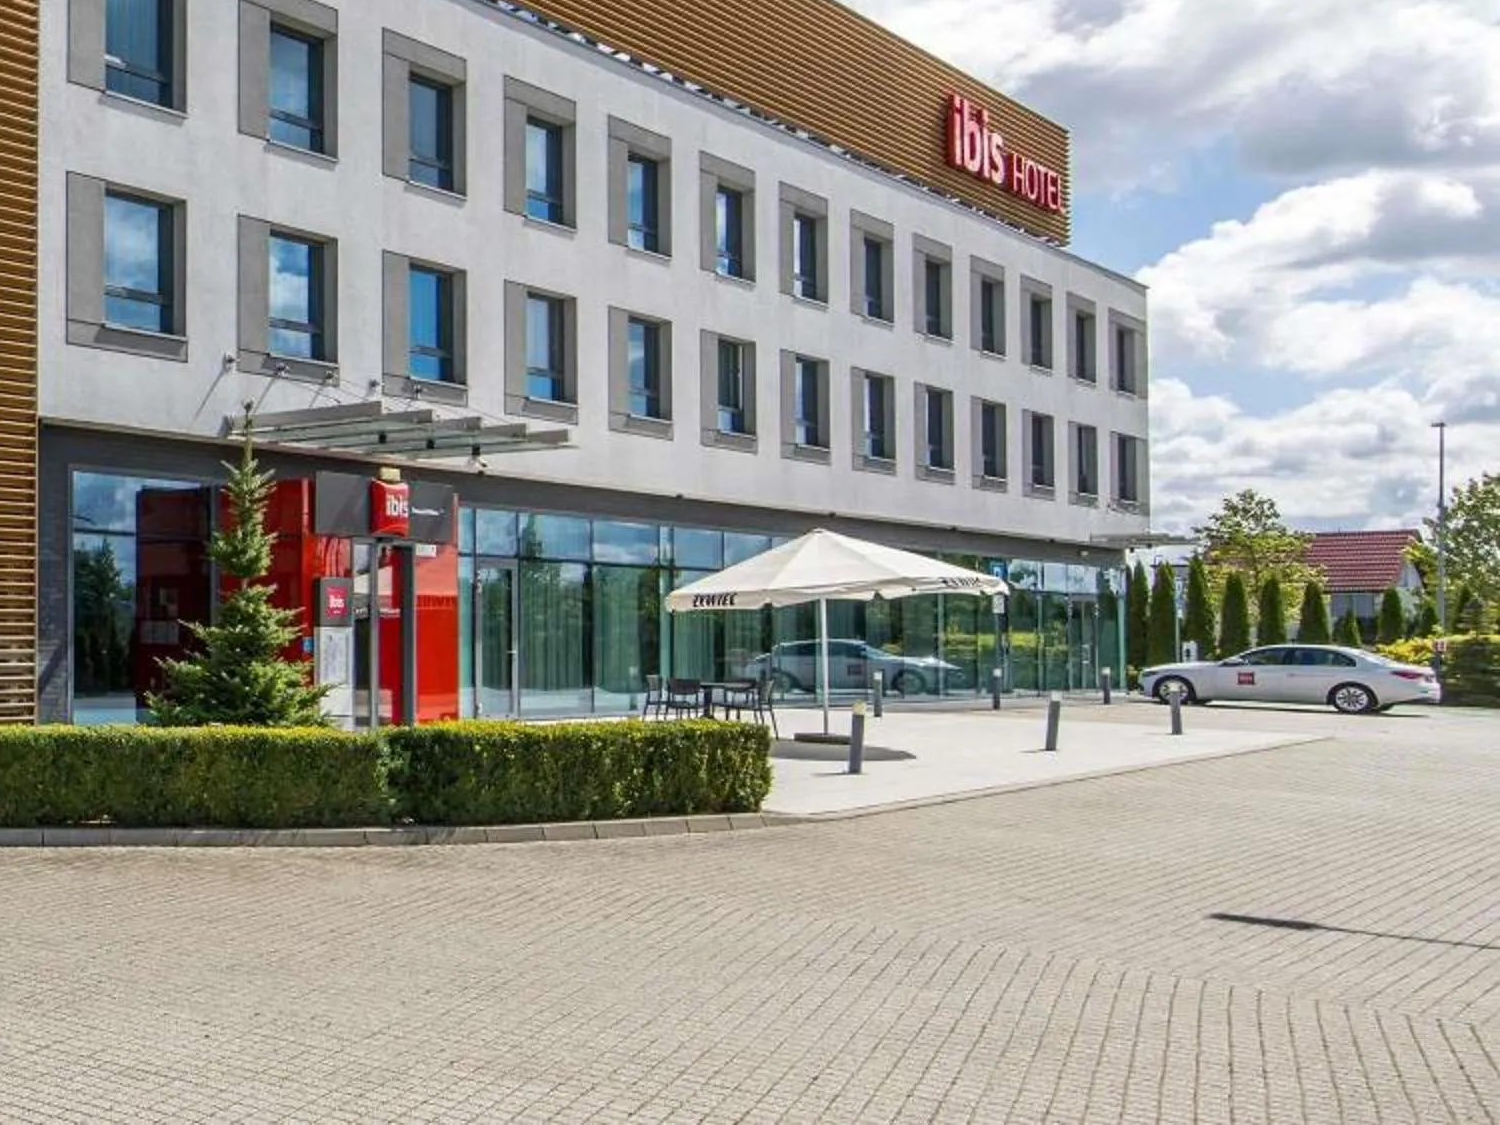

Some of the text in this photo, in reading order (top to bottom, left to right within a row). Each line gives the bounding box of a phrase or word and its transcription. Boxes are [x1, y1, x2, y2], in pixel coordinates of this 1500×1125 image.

[952, 93, 1065, 214] ibis HOTEL
[385, 494, 409, 518] ibis
